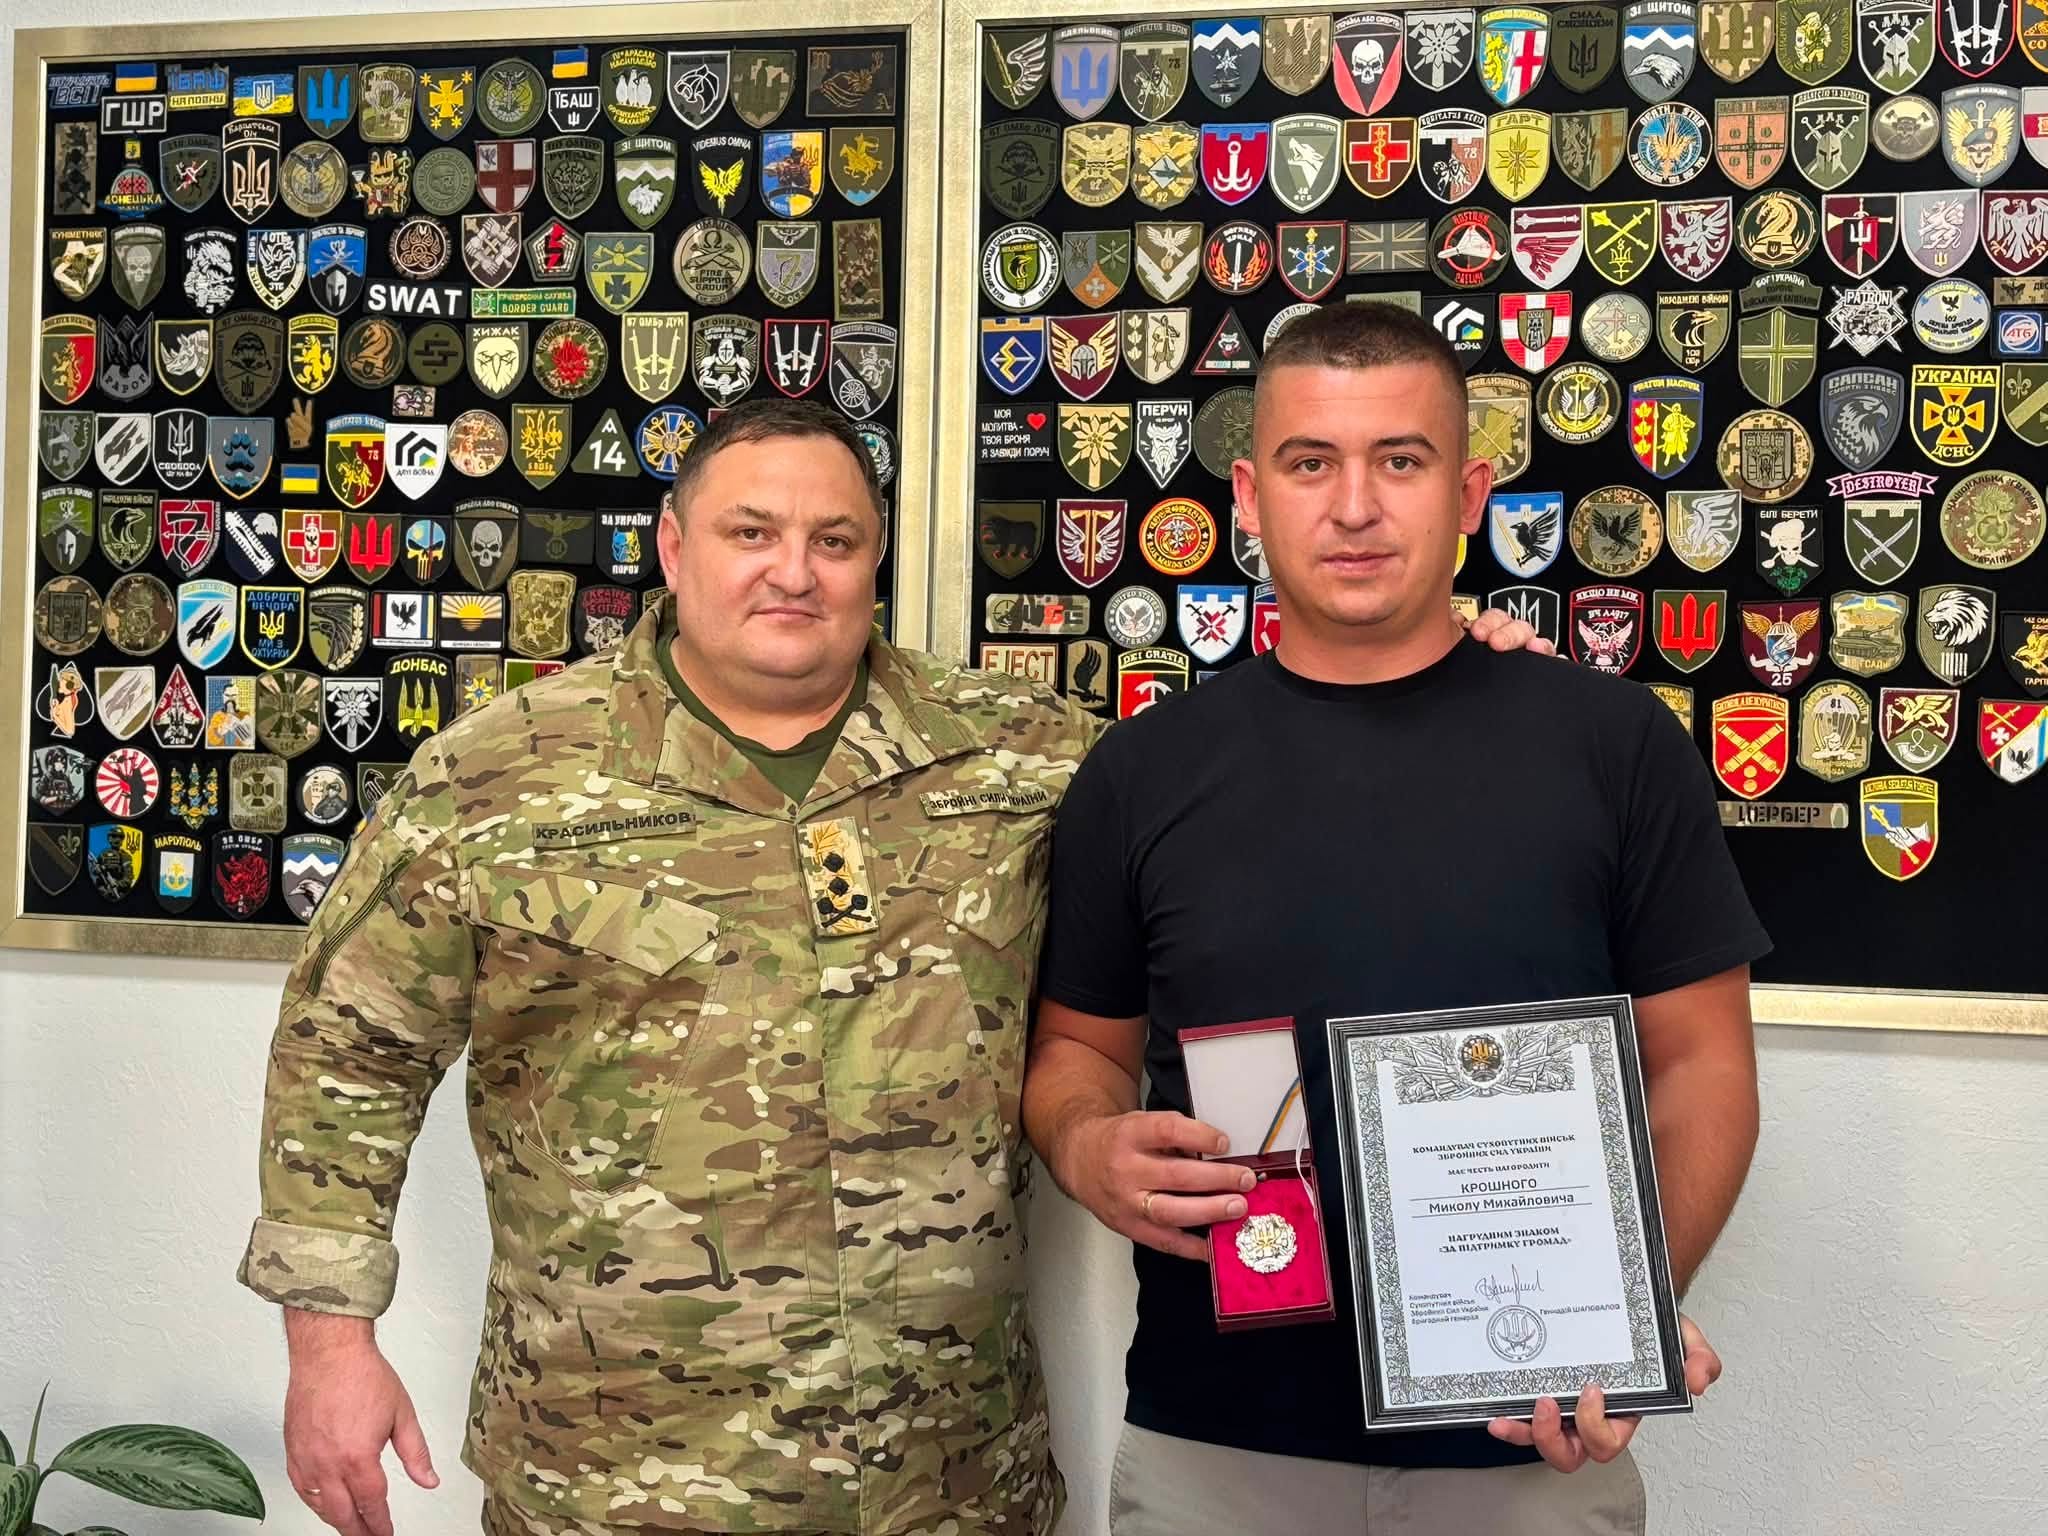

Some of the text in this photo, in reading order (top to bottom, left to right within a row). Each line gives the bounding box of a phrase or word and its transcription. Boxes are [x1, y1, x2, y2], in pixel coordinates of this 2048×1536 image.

[1647, 3, 1691, 16] ЩИТОМ
[555, 91, 593, 109] ЇБАШ
[1220, 94, 1232, 103] ТБ
[105, 100, 164, 128] ГШР
[1496, 113, 1543, 127] ГАРТ
[1640, 105, 1670, 127] DEATH
[1683, 107, 1705, 128] STAR
[635, 138, 672, 151] ЩИТОМ
[693, 136, 726, 151] VIDEMUS
[727, 136, 752, 150] OMNIA
[1464, 147, 1477, 159] 78
[104, 193, 163, 205] ДОНЕЦЬКА
[1156, 192, 1168, 202] 92
[1756, 276, 1770, 288] БОГ
[1775, 274, 1805, 287] УКРАЇНА
[368, 284, 463, 315] SWAT
[1846, 291, 1891, 306] PATRON
[502, 302, 569, 314] BORDER GUARD
[472, 326, 520, 337] ХИЖАК
[1829, 373, 1898, 390] САПСАН
[1917, 367, 1995, 384] УКРАЇНА
[104, 373, 148, 395] РАРОГ
[994, 409, 1012, 420] МОЯ
[982, 423, 1018, 433] МОЛИТВА
[981, 434, 1031, 446] ТВОЯ БРОНЯ
[590, 440, 626, 472] 14
[981, 447, 1050, 459] Я ЗАВЖДИ ПОРУЧ
[1932, 444, 1976, 459] ДСНС
[159, 462, 201, 471] СВОБОДА
[1846, 477, 1918, 493] DESTROYER
[1948, 475, 2003, 510] НАЦІОНАЛЬНА
[614, 513, 652, 526] УКРАЇНУ
[1760, 509, 1818, 519] БІЛІ БЕРЕТИ
[248, 592, 300, 602] ДОБРОГО
[1606, 587, 1620, 599] НЕ
[251, 602, 295, 613] ВЕЧОРА
[258, 639, 274, 649] МИ
[1117, 631, 1153, 645] VETERAN
[252, 648, 290, 659] ОХТИРКИ
[1123, 650, 1185, 665] DEI GRATIA
[390, 657, 447, 677] ДОНБАС
[1772, 673, 1792, 686] 25
[1830, 699, 1842, 708] 81
[930, 795, 977, 809] ЗБРОЙНІ
[980, 792, 1007, 803] СИЛИ
[1739, 806, 1820, 823] ЦЕРБЕР
[536, 812, 690, 840] КРАСИЛЬНИКОВ
[1412, 1135, 1575, 1154] КОМАНДУВАЧ СУХОПУТНИХ ВІЙСЬК
[1438, 1145, 1551, 1160] ЗБРОЙНИХ СИЛ УКРАЇНИ
[1467, 1166, 1494, 1174] ЧЕСТЬ
[1495, 1162, 1550, 1172] НАГОРОДИТИ
[1461, 1178, 1537, 1194] КРОШНОГО
[1429, 1194, 1574, 1214] Миколу Михайловича
[1448, 1227, 1560, 1242] НАГРУДНИМ ЗНАКОМ
[1459, 1241, 1520, 1253] ПІДТРИМКУ
